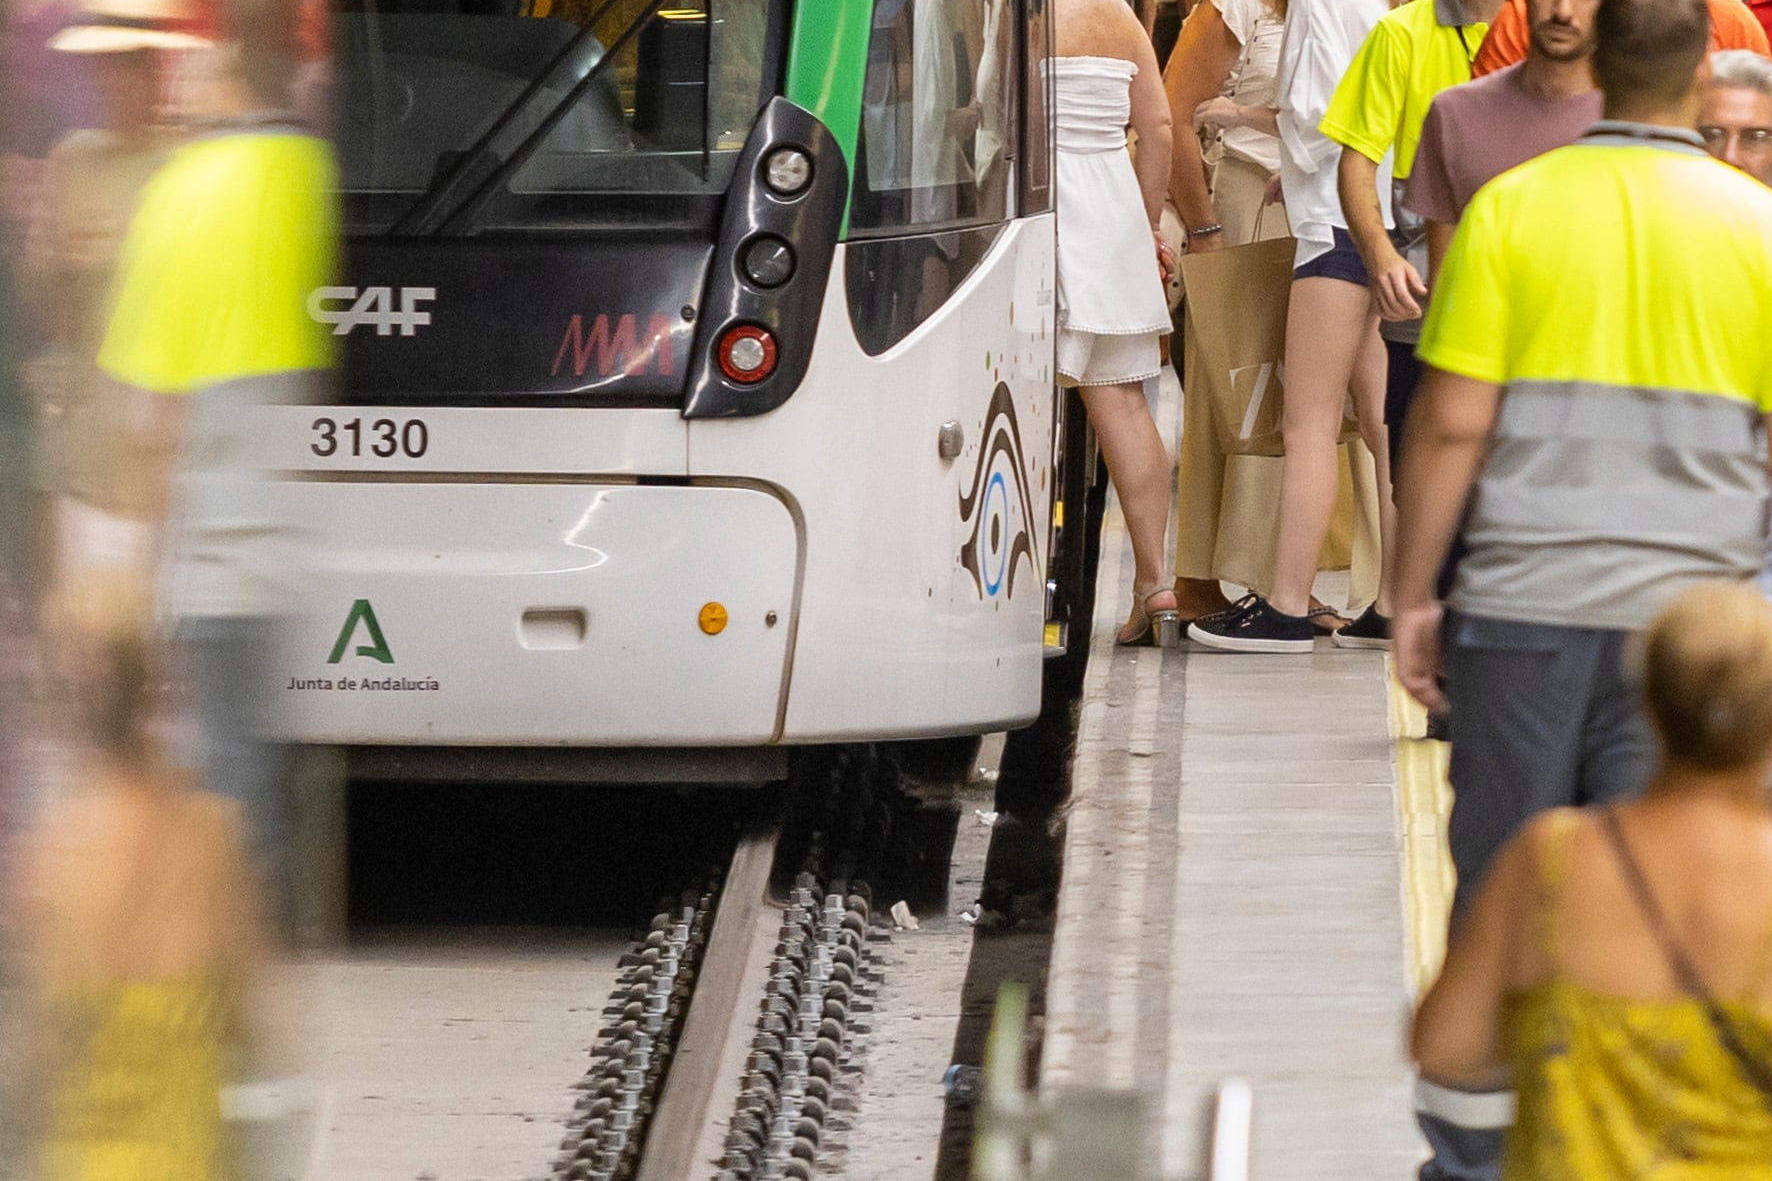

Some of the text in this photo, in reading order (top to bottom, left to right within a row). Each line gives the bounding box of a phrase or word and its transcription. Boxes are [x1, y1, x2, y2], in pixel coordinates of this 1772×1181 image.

[306, 286, 437, 336] CAF
[310, 418, 429, 458] 3130
[287, 676, 440, 691] Junta de Andalucía
